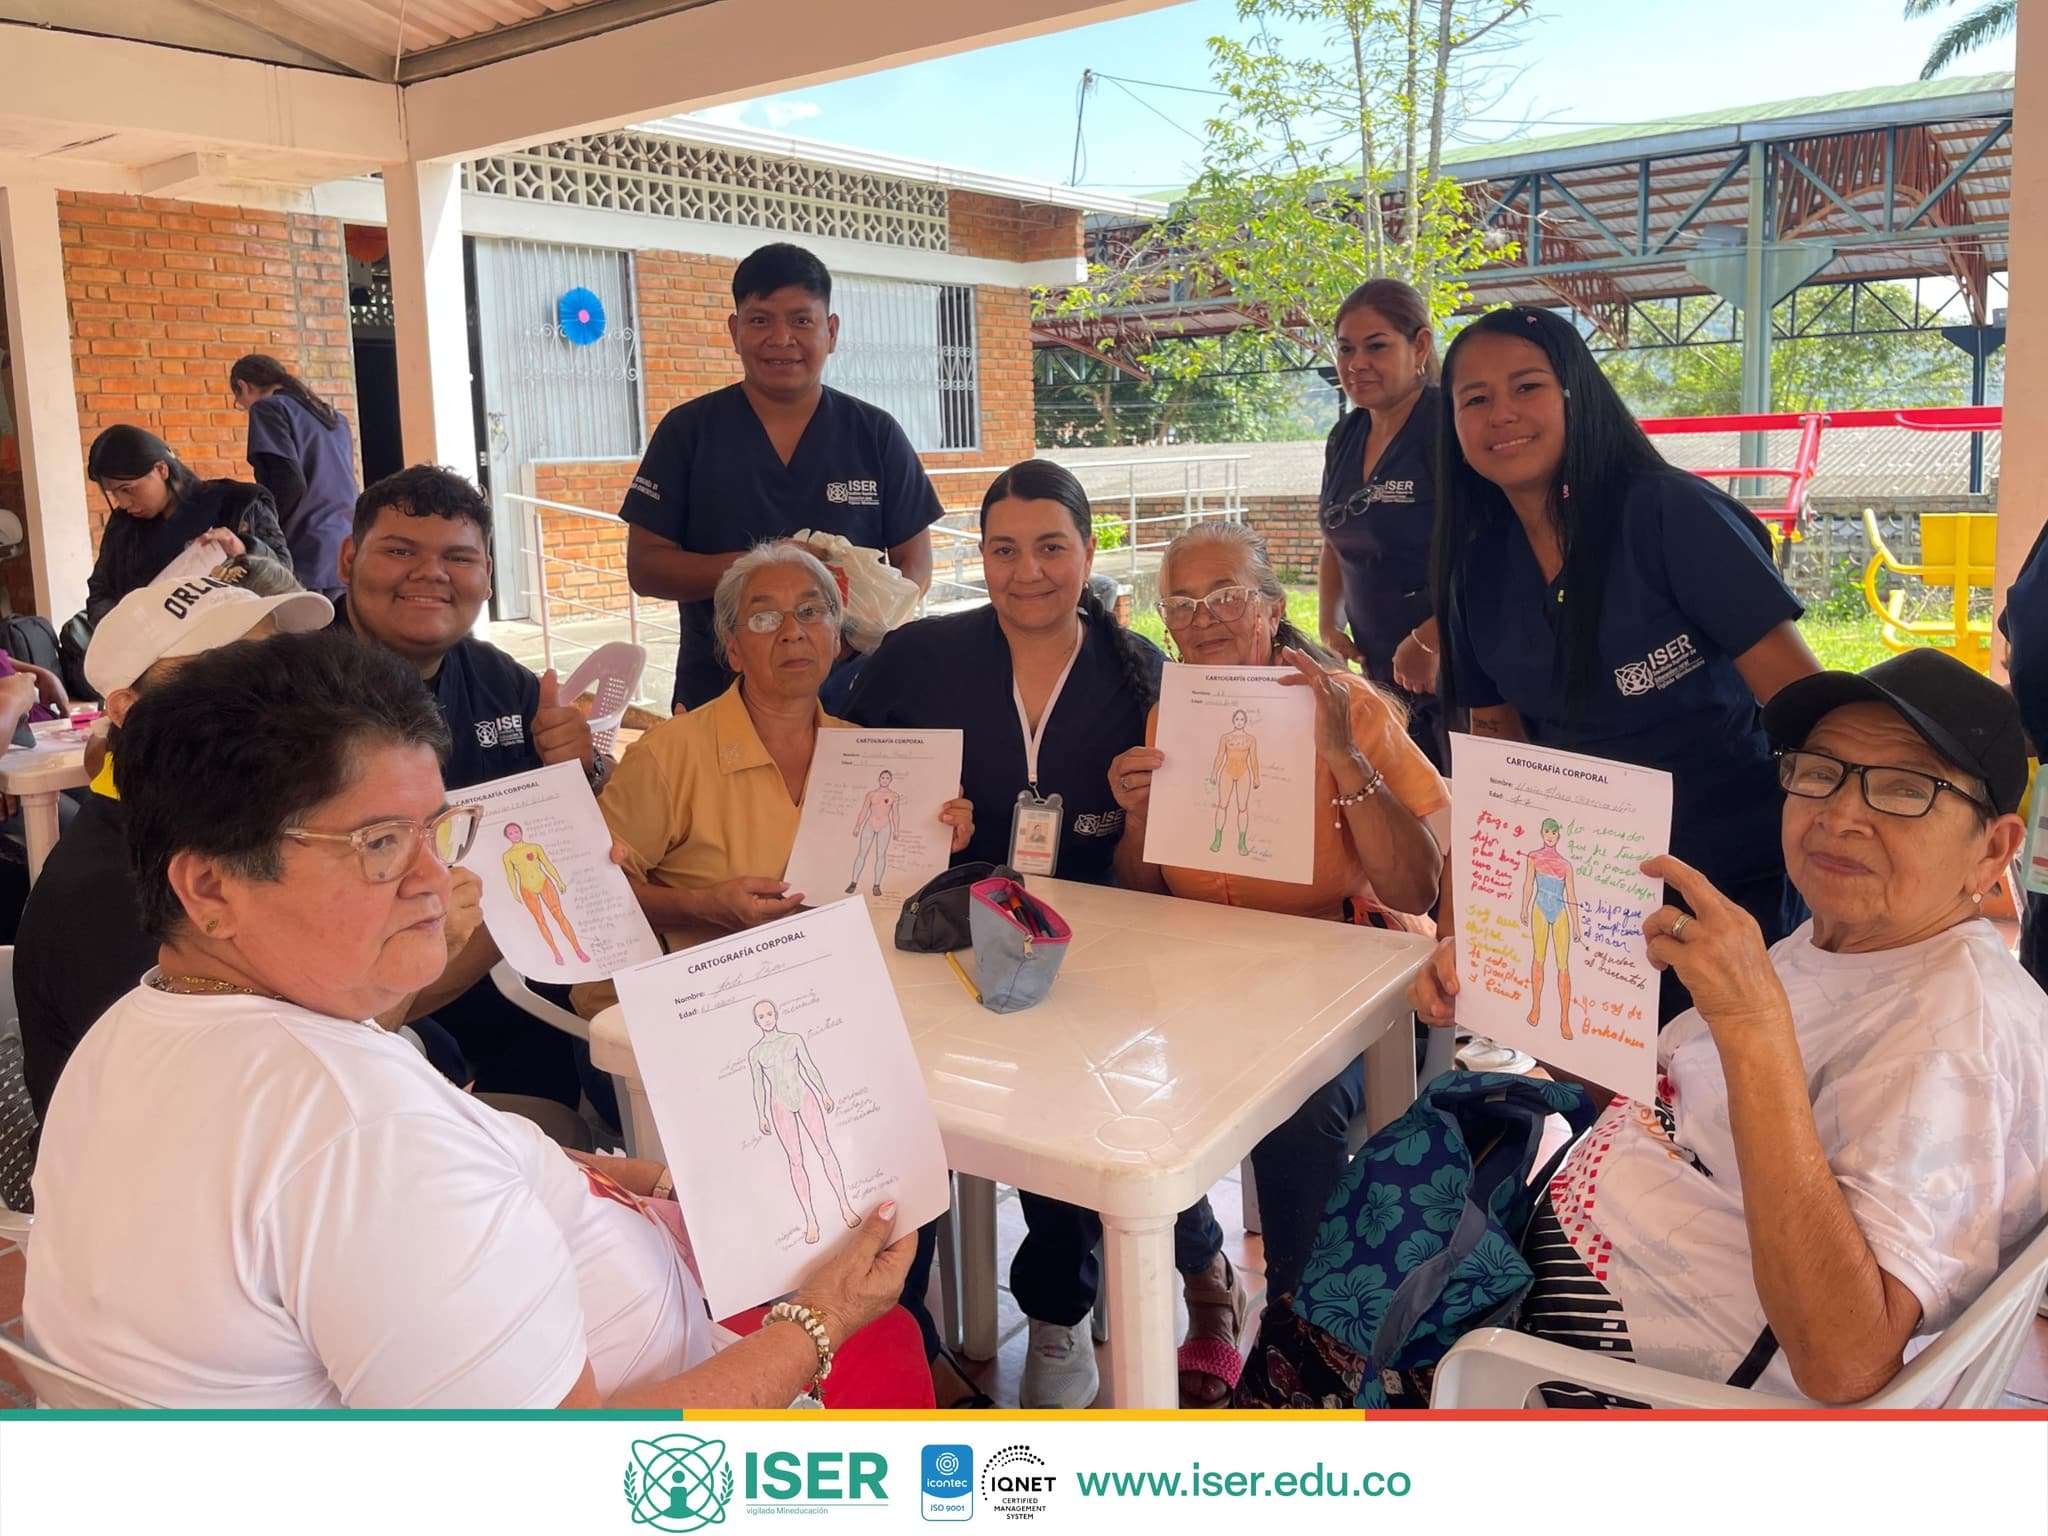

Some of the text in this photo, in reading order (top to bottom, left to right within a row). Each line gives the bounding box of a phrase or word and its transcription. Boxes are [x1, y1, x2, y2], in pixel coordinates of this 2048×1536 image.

[848, 480, 878, 493] ISER
[1385, 480, 1414, 491] ISER
[1648, 634, 1693, 670] ISER
[1562, 768, 1609, 785] CORPORAL
[503, 781, 540, 796] CORPORAL
[687, 931, 806, 975] CARTOGRAFÍA CORPORAL
